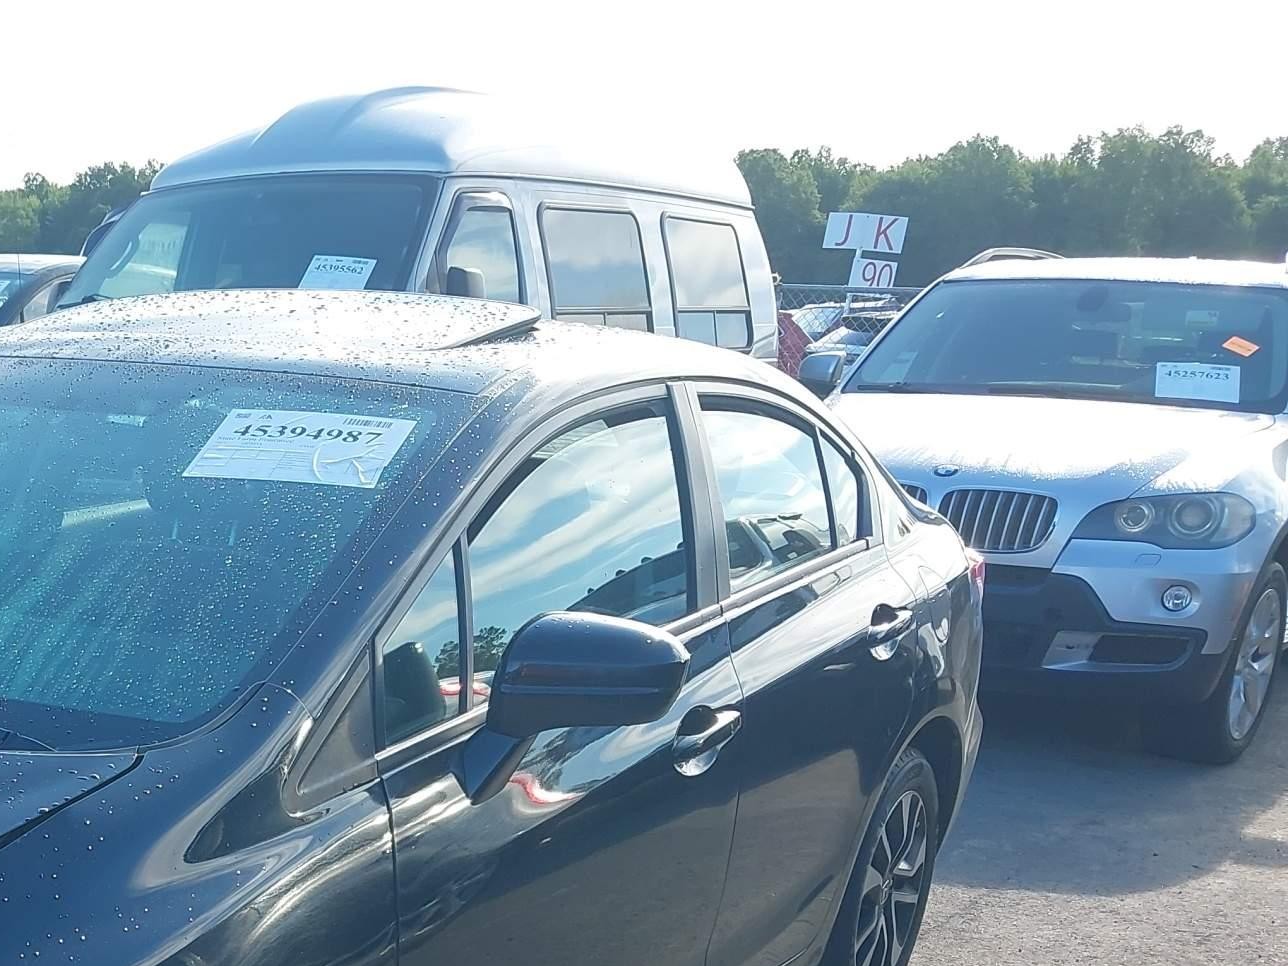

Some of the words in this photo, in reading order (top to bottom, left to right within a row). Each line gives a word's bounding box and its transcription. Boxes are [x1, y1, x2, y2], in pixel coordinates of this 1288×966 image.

[834, 214, 854, 247] J
[873, 216, 900, 251] K
[314, 263, 364, 274] 45395562
[861, 261, 894, 288] 90
[1164, 369, 1231, 381] 45257623
[233, 423, 383, 444] 45394987
